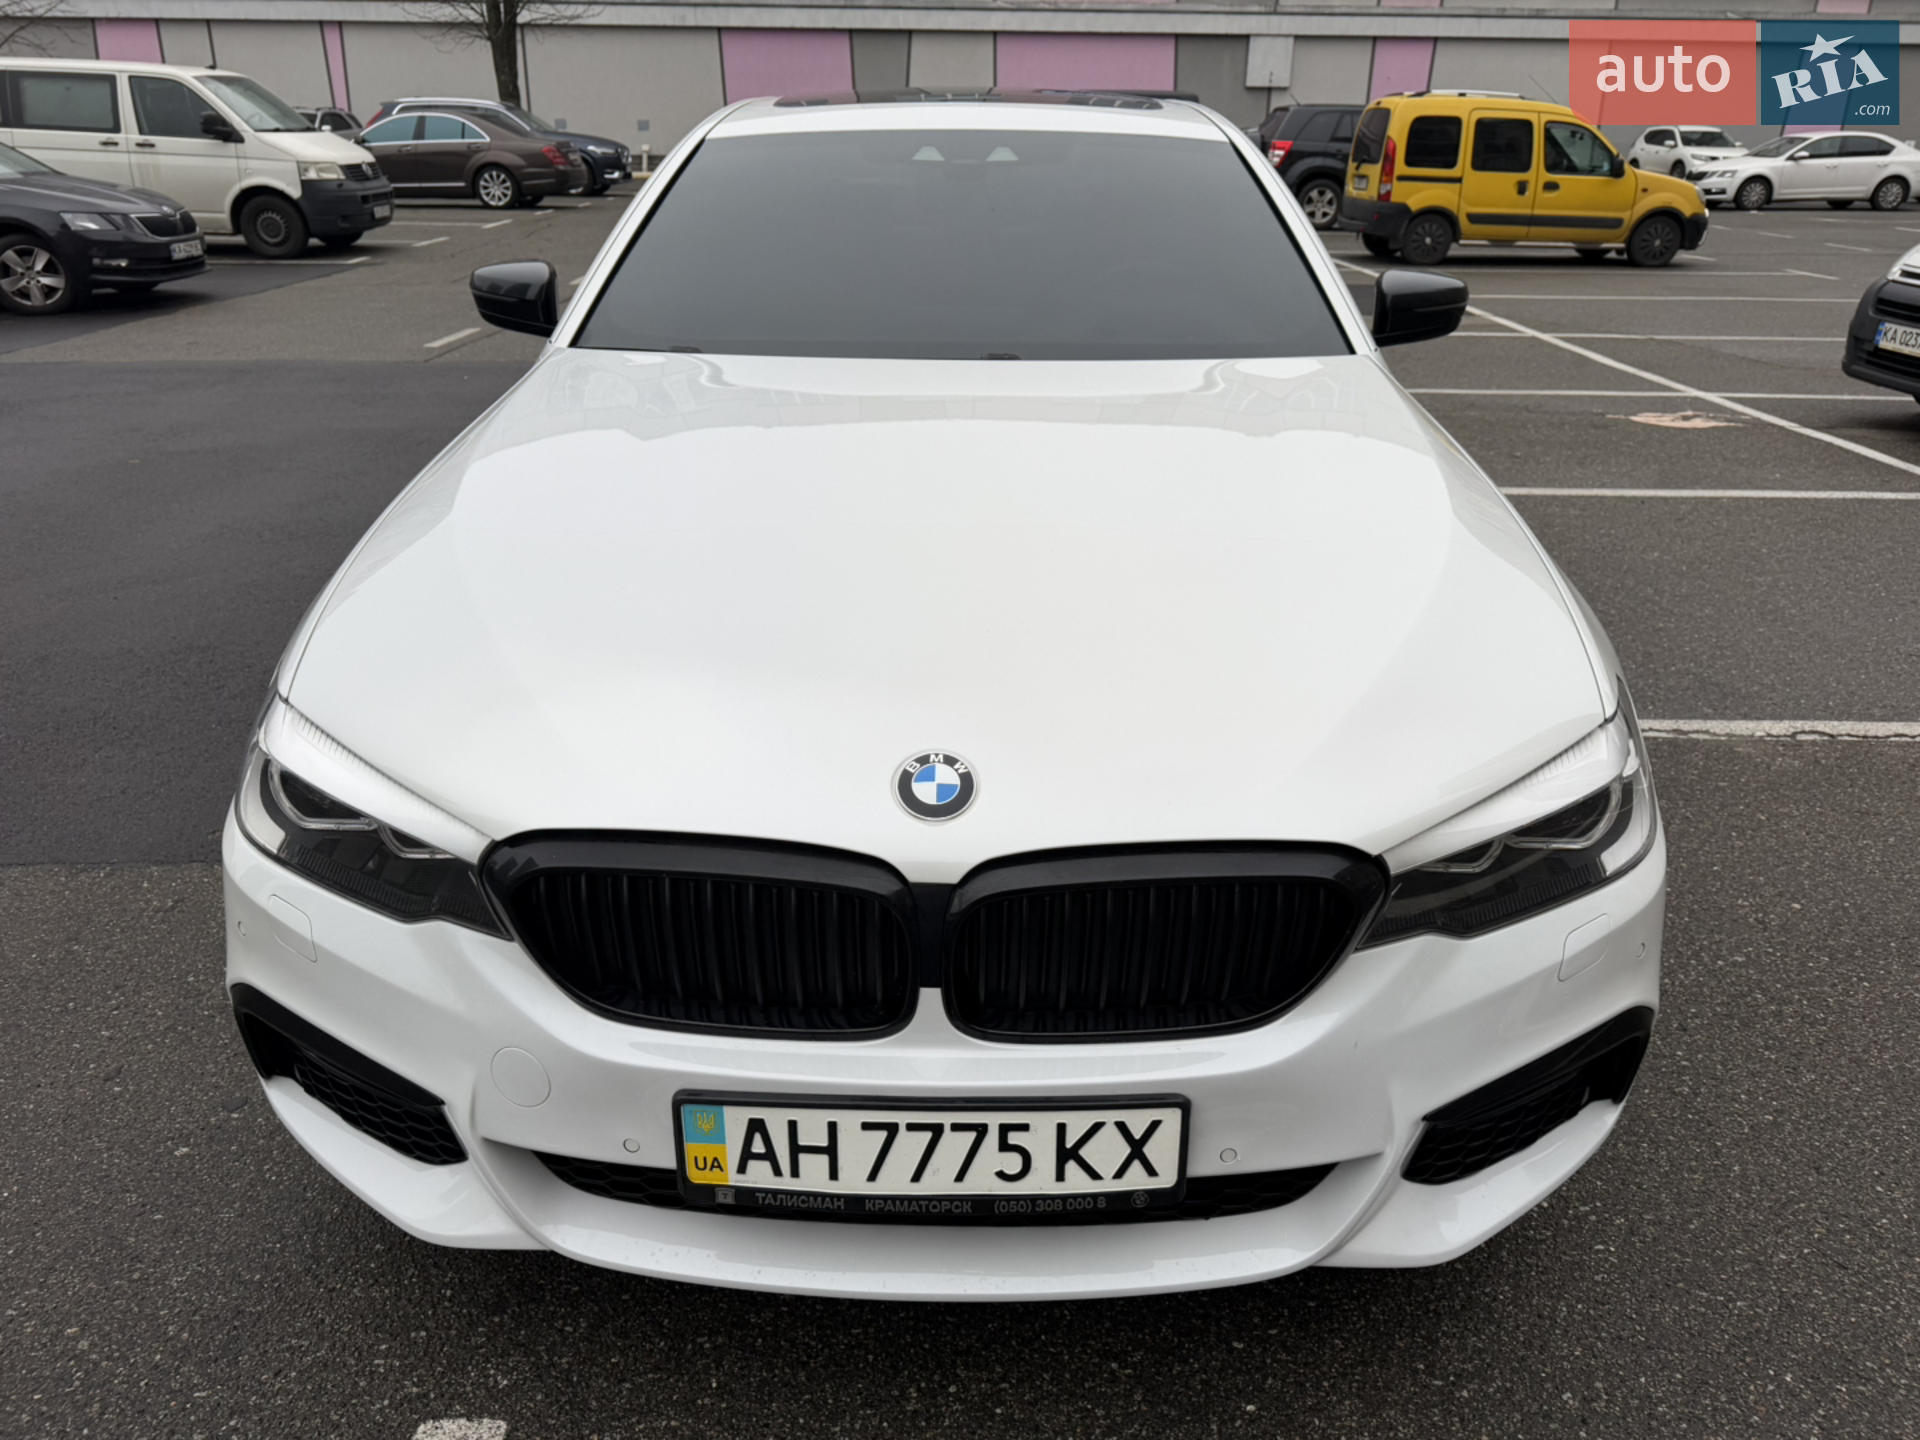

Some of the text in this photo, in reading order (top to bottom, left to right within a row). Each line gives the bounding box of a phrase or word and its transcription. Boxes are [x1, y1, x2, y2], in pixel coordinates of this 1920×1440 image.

[1882, 326, 1920, 349] KA 023
[905, 754, 969, 774] BMW
[736, 1117, 1163, 1183] AH 7775 KX
[694, 1156, 725, 1172] UA
[755, 1192, 1106, 1214] ТАЛИСМАН КРАМАТОРСК (050) 308 000 8
